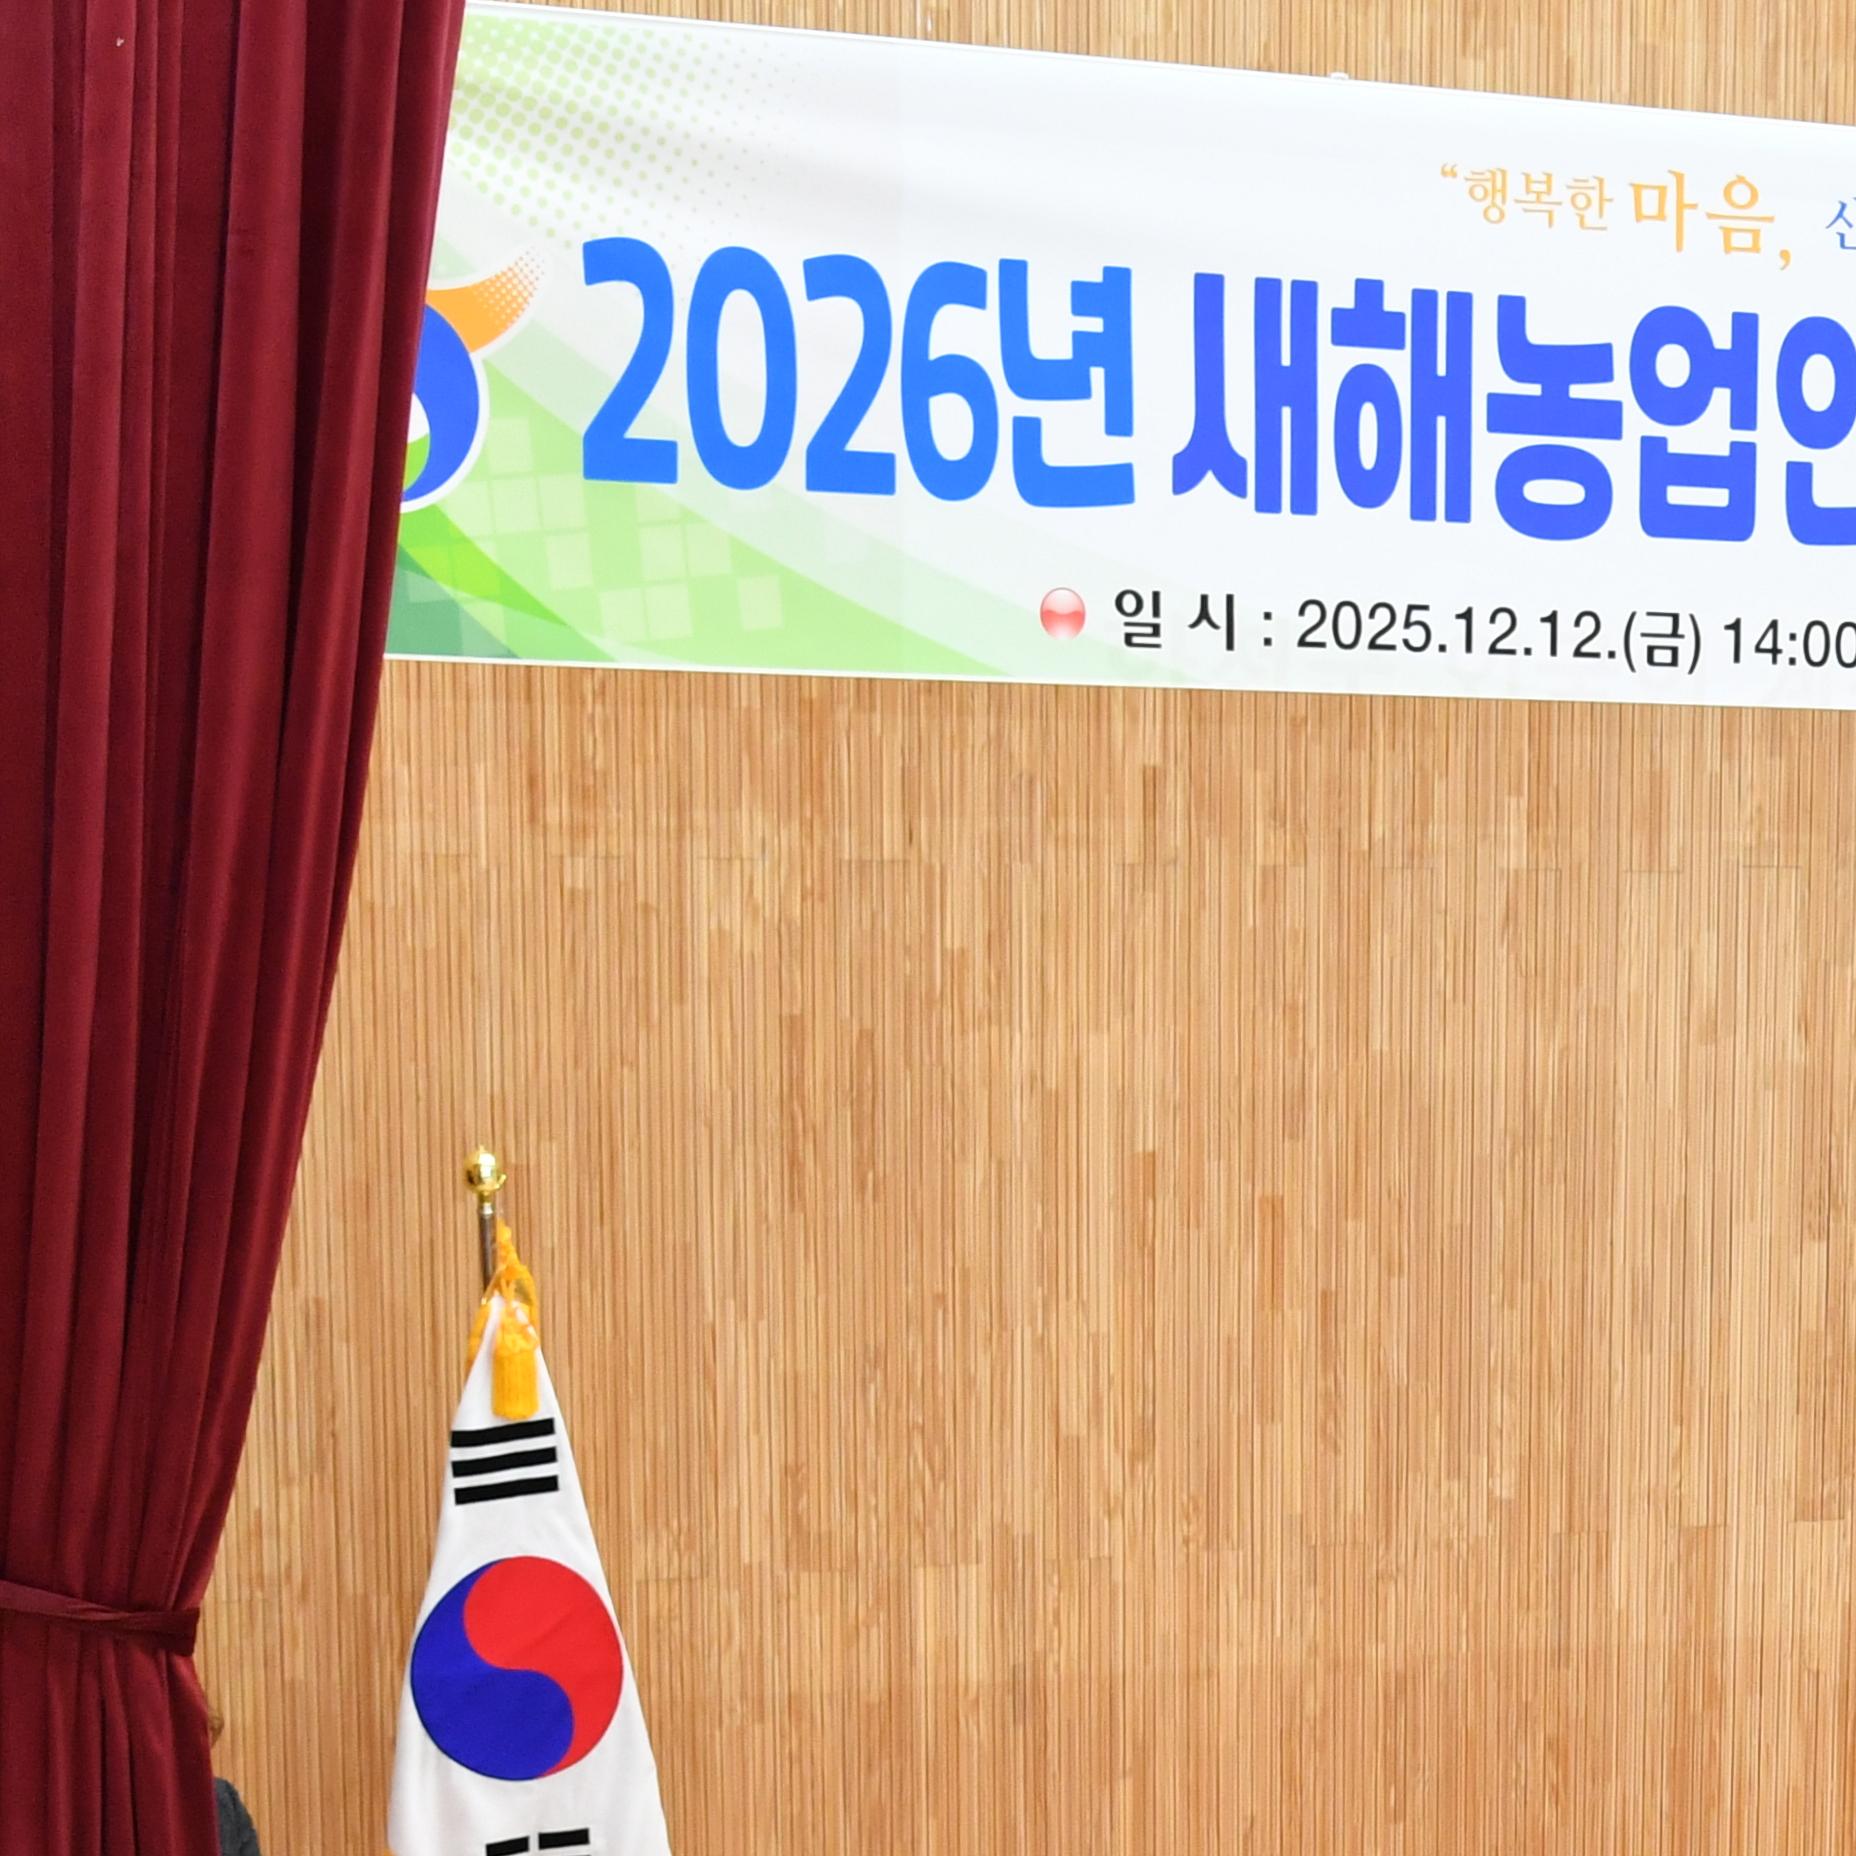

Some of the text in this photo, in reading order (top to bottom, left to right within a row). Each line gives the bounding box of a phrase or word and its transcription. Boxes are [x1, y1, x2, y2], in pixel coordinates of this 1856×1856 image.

[1628, 169, 1792, 271] 마음,
[581, 236, 1136, 510] 2026년
[1296, 598, 1702, 675] 2025.12.12.(금)
